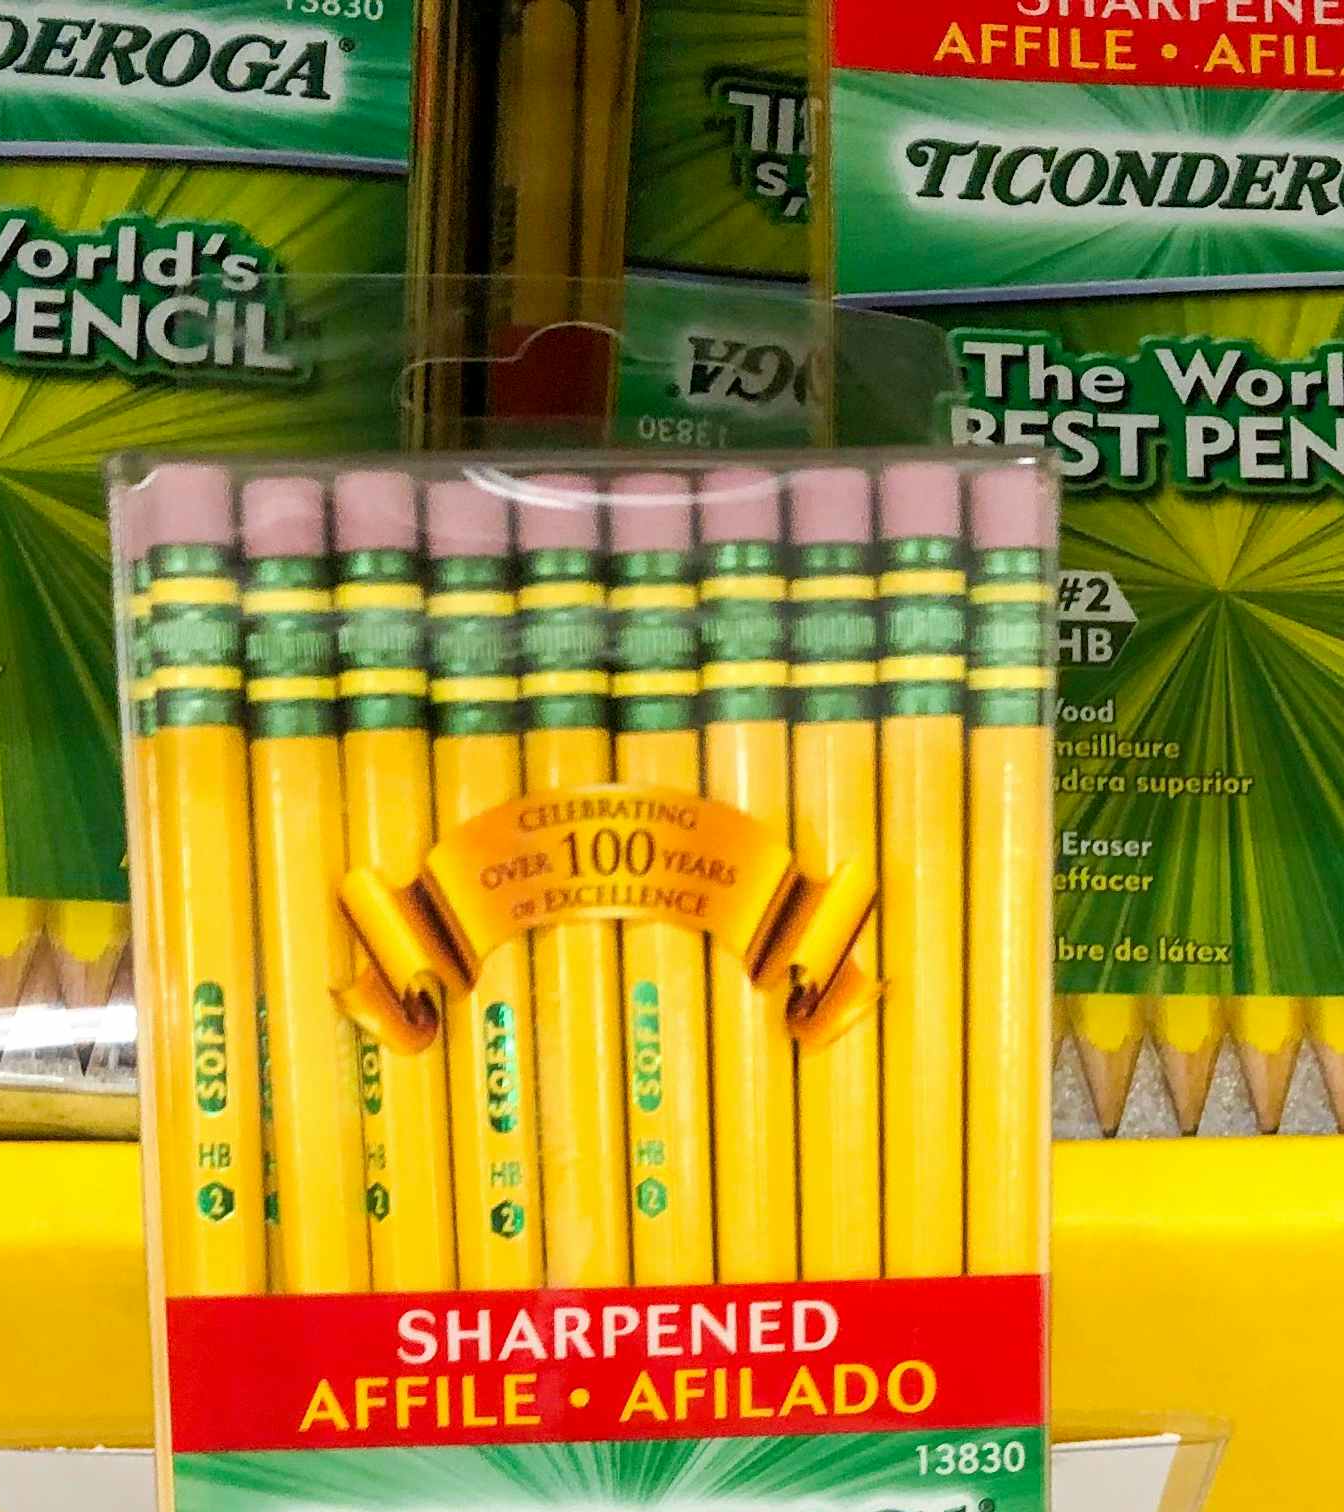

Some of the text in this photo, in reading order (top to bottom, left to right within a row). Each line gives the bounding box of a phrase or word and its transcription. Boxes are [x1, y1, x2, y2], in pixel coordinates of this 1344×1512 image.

[284, 0, 385, 23] 13830
[934, 23, 1138, 71] AFFILE
[962, 341, 1125, 402] The
[1058, 576, 1111, 613] #2
[1055, 699, 1115, 723] ood
[1136, 770, 1253, 798] superior
[517, 799, 699, 832] CELEBRATING
[479, 827, 736, 890] OVER 100 YEARS
[1062, 831, 1153, 857] Eraser
[1054, 866, 1153, 893] effacer
[544, 884, 710, 916] EXCELLENCE
[1115, 936, 1232, 963] de látex
[194, 1000, 229, 1101] SOFT
[633, 999, 663, 1099] SOFT
[485, 1022, 519, 1117] SOFT
[198, 1143, 232, 1168] HB
[636, 1139, 665, 1166] HB
[491, 1161, 521, 1186] HB
[397, 1300, 840, 1363] SHARPENED
[299, 1361, 938, 1431] AFFILE AFILADO
[914, 1442, 1027, 1477] 13830
